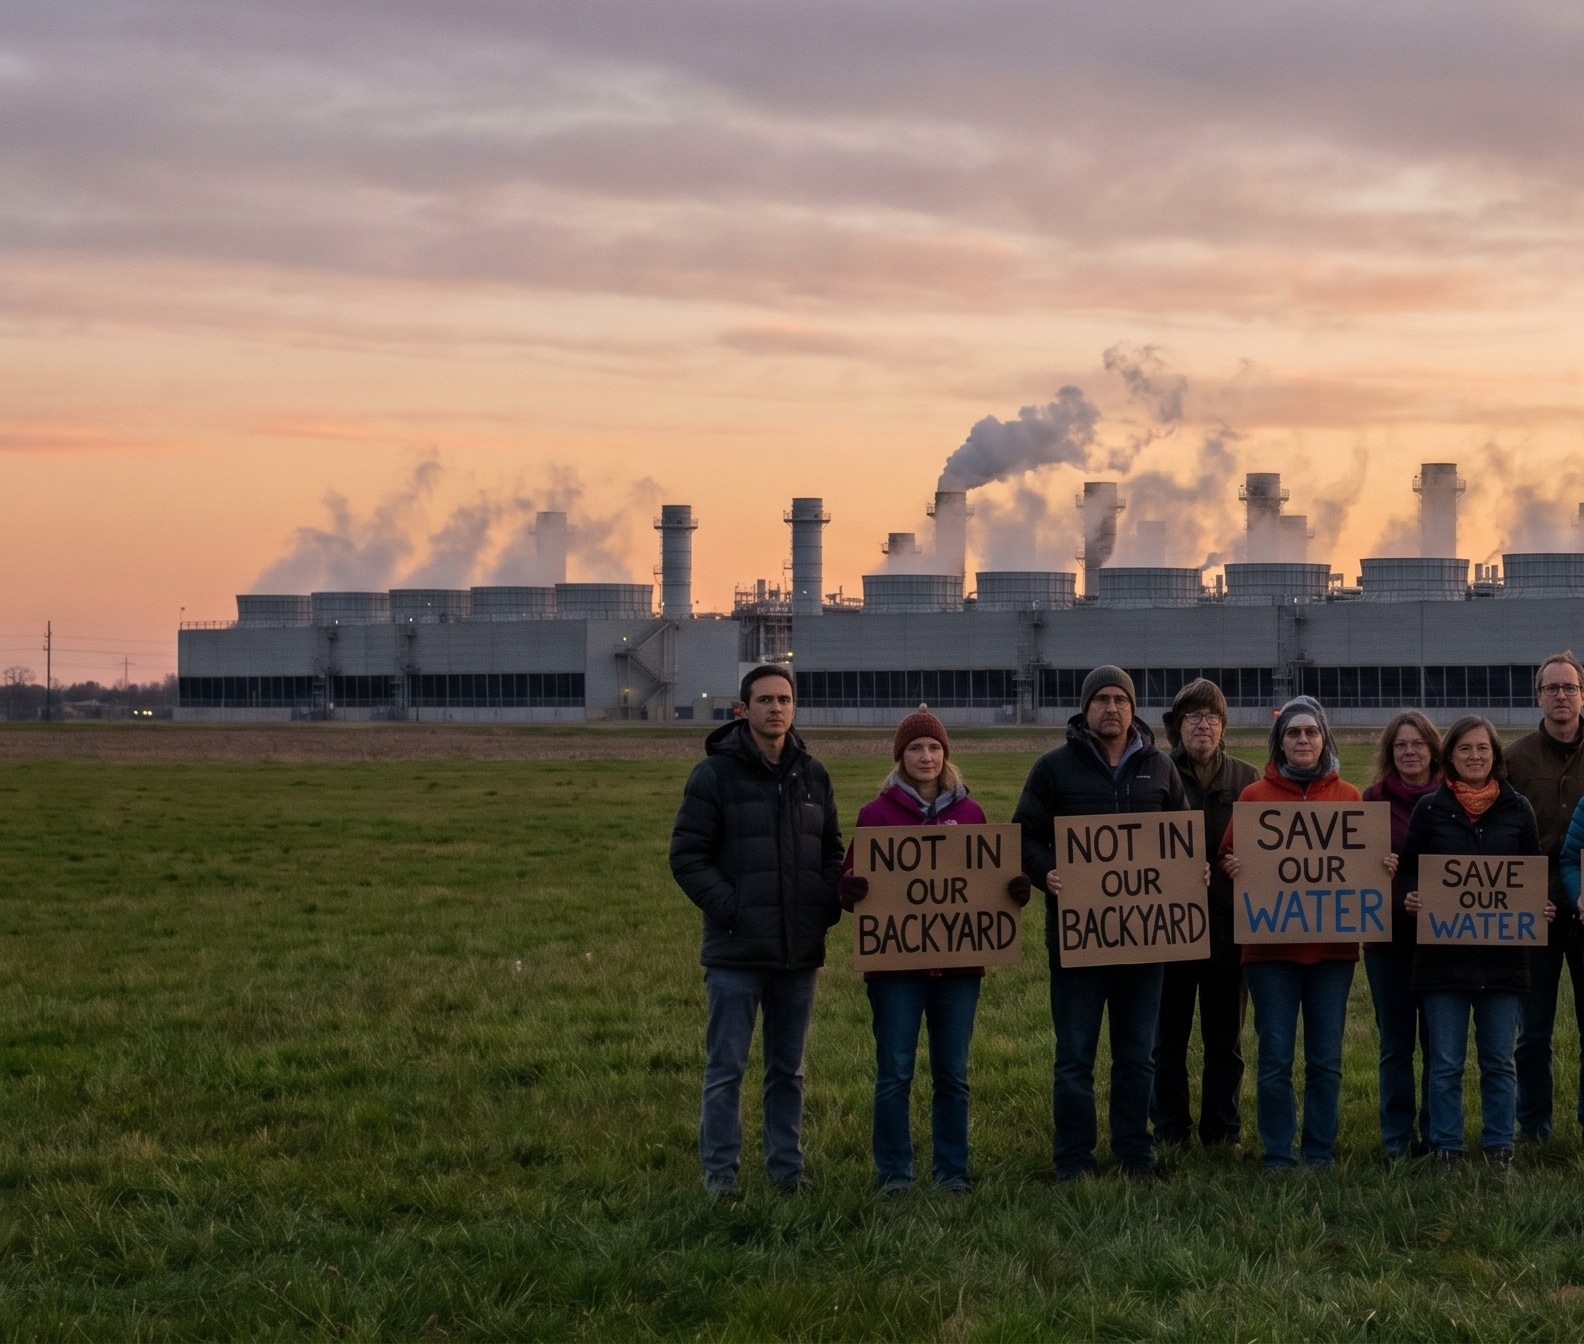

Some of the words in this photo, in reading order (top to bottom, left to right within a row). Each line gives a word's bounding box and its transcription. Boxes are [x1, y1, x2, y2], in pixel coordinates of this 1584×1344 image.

[1068, 823, 1141, 864] NOT
[1158, 821, 1194, 860] IN
[1258, 809, 1366, 851] SAVE
[870, 834, 946, 872] NOT
[965, 834, 1001, 870] IN
[1279, 856, 1346, 884] OUR
[1102, 868, 1162, 898] OUR
[1442, 859, 1525, 888] SAVE
[907, 877, 968, 905] OUR
[1460, 890, 1508, 910] OUR
[1062, 902, 1207, 951] BACKYARD
[1243, 888, 1385, 933] WATER
[1428, 911, 1537, 941] WATER
[859, 911, 1016, 956] BACKYARD
